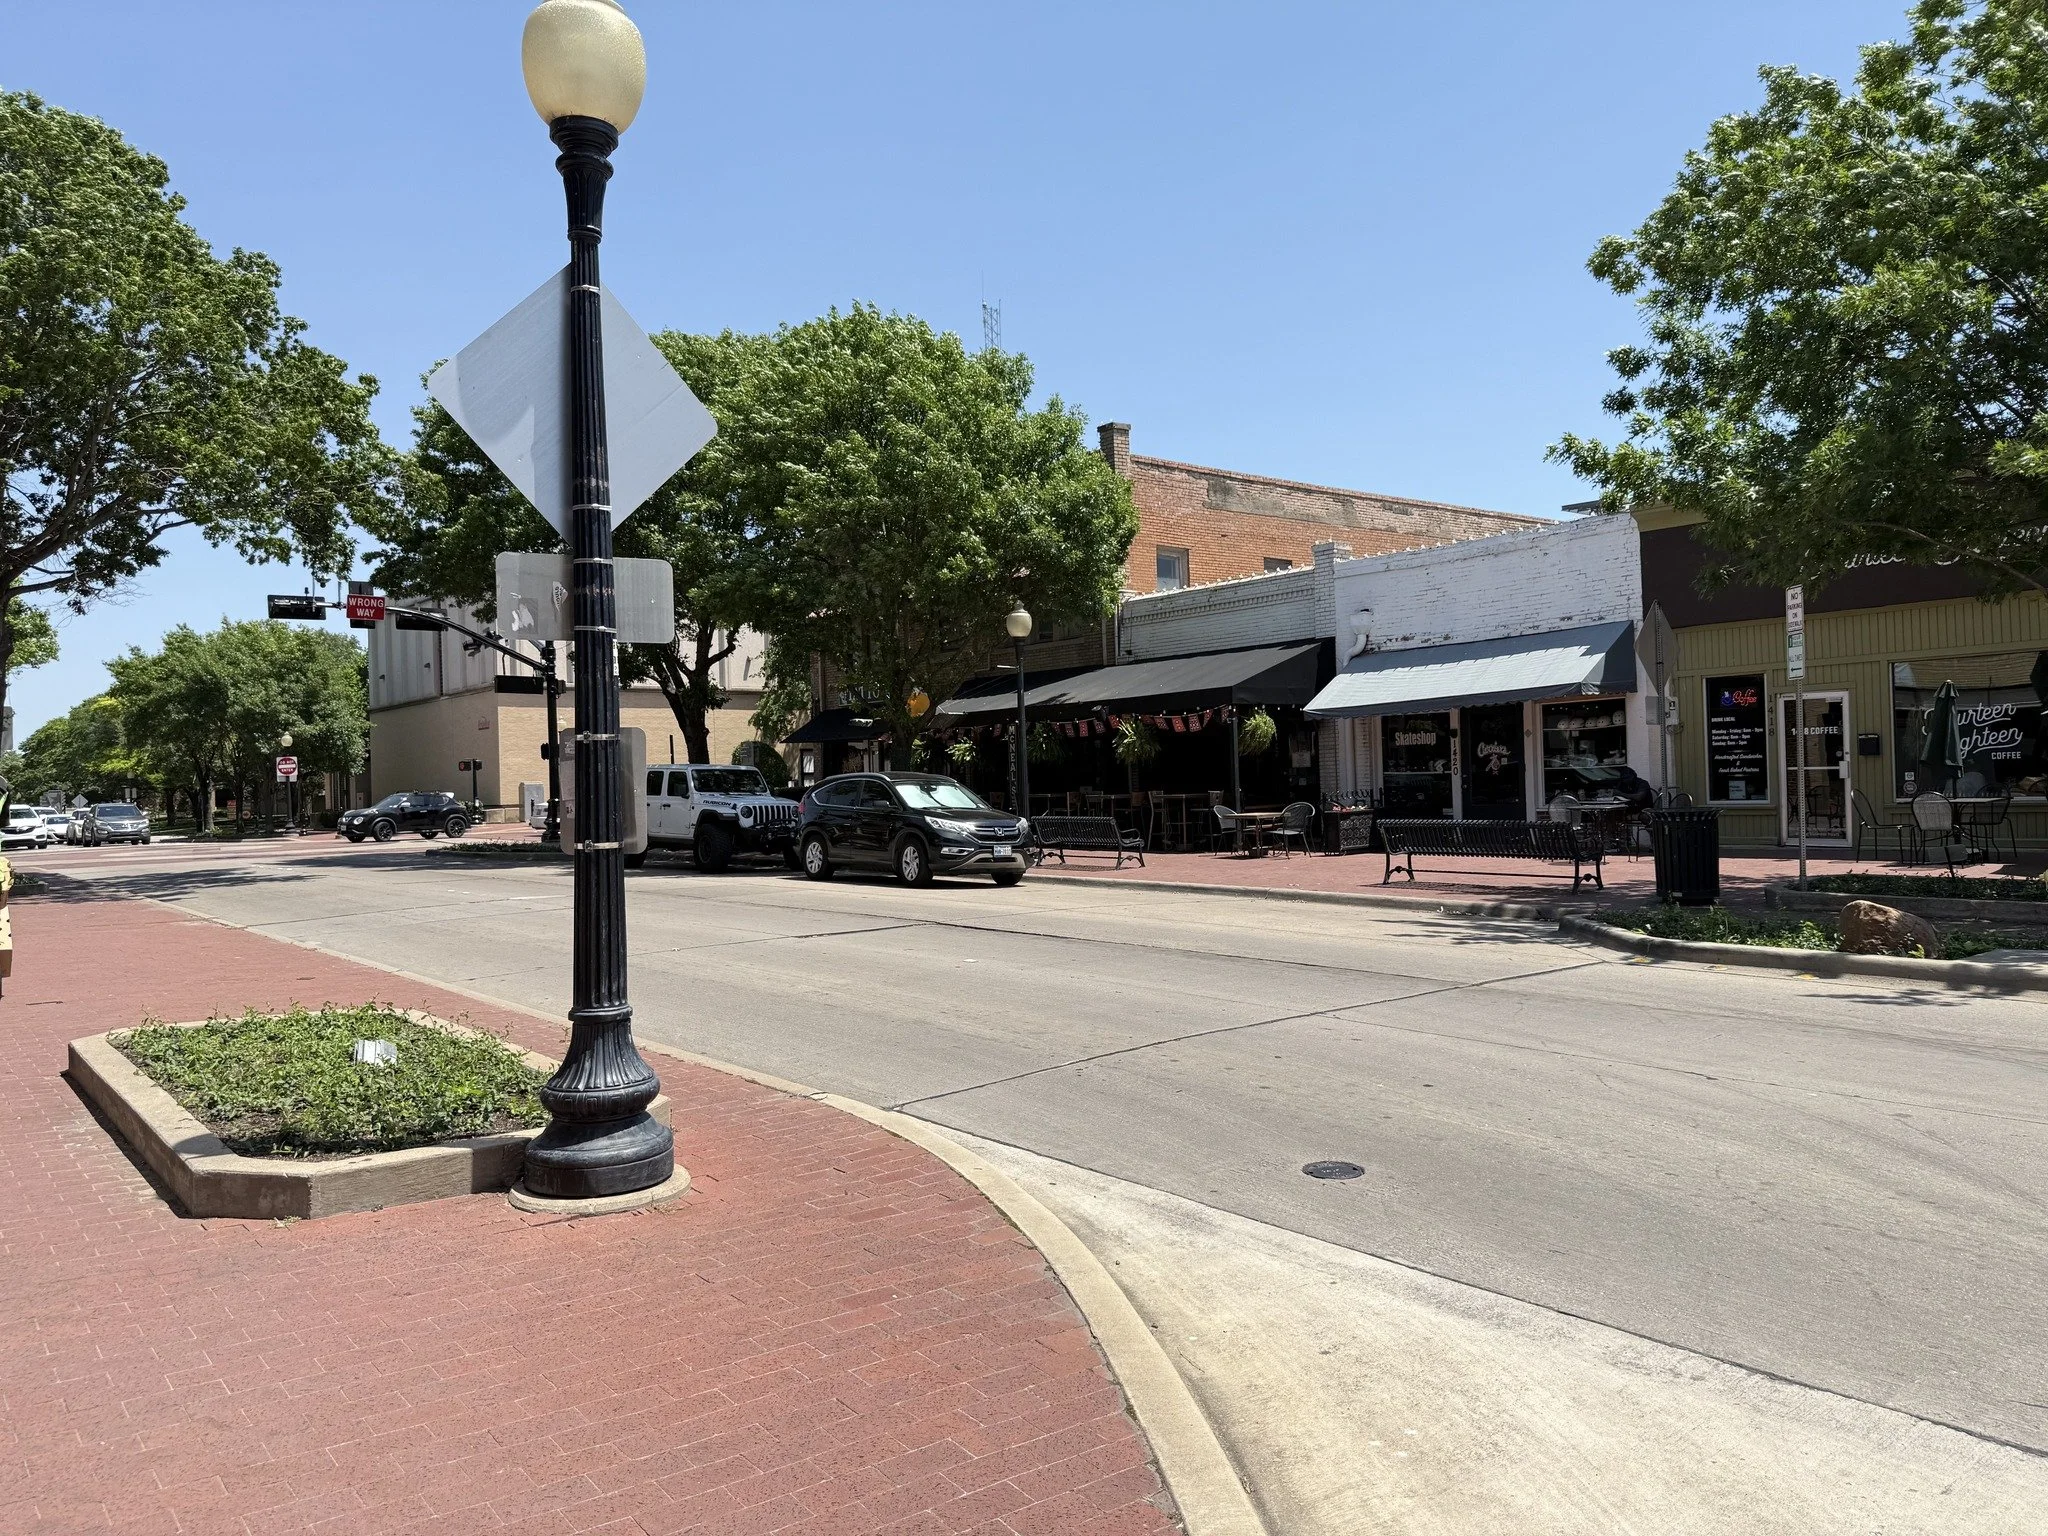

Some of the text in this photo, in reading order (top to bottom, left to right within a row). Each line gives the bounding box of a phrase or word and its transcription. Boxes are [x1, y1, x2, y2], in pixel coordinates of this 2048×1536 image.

[1790, 592, 1799, 601] NO
[348, 597, 384, 608] WRONG
[356, 608, 376, 618] WAY
[1733, 688, 1758, 707] Coffee
[1767, 694, 1775, 737] 1418
[1791, 726, 1839, 735] 18 COFFEE
[1395, 731, 1437, 746] Skateshop
[1960, 726, 2024, 759] ghteen
[1991, 751, 2022, 760] COFFEE
[702, 799, 732, 807] RUBICON
